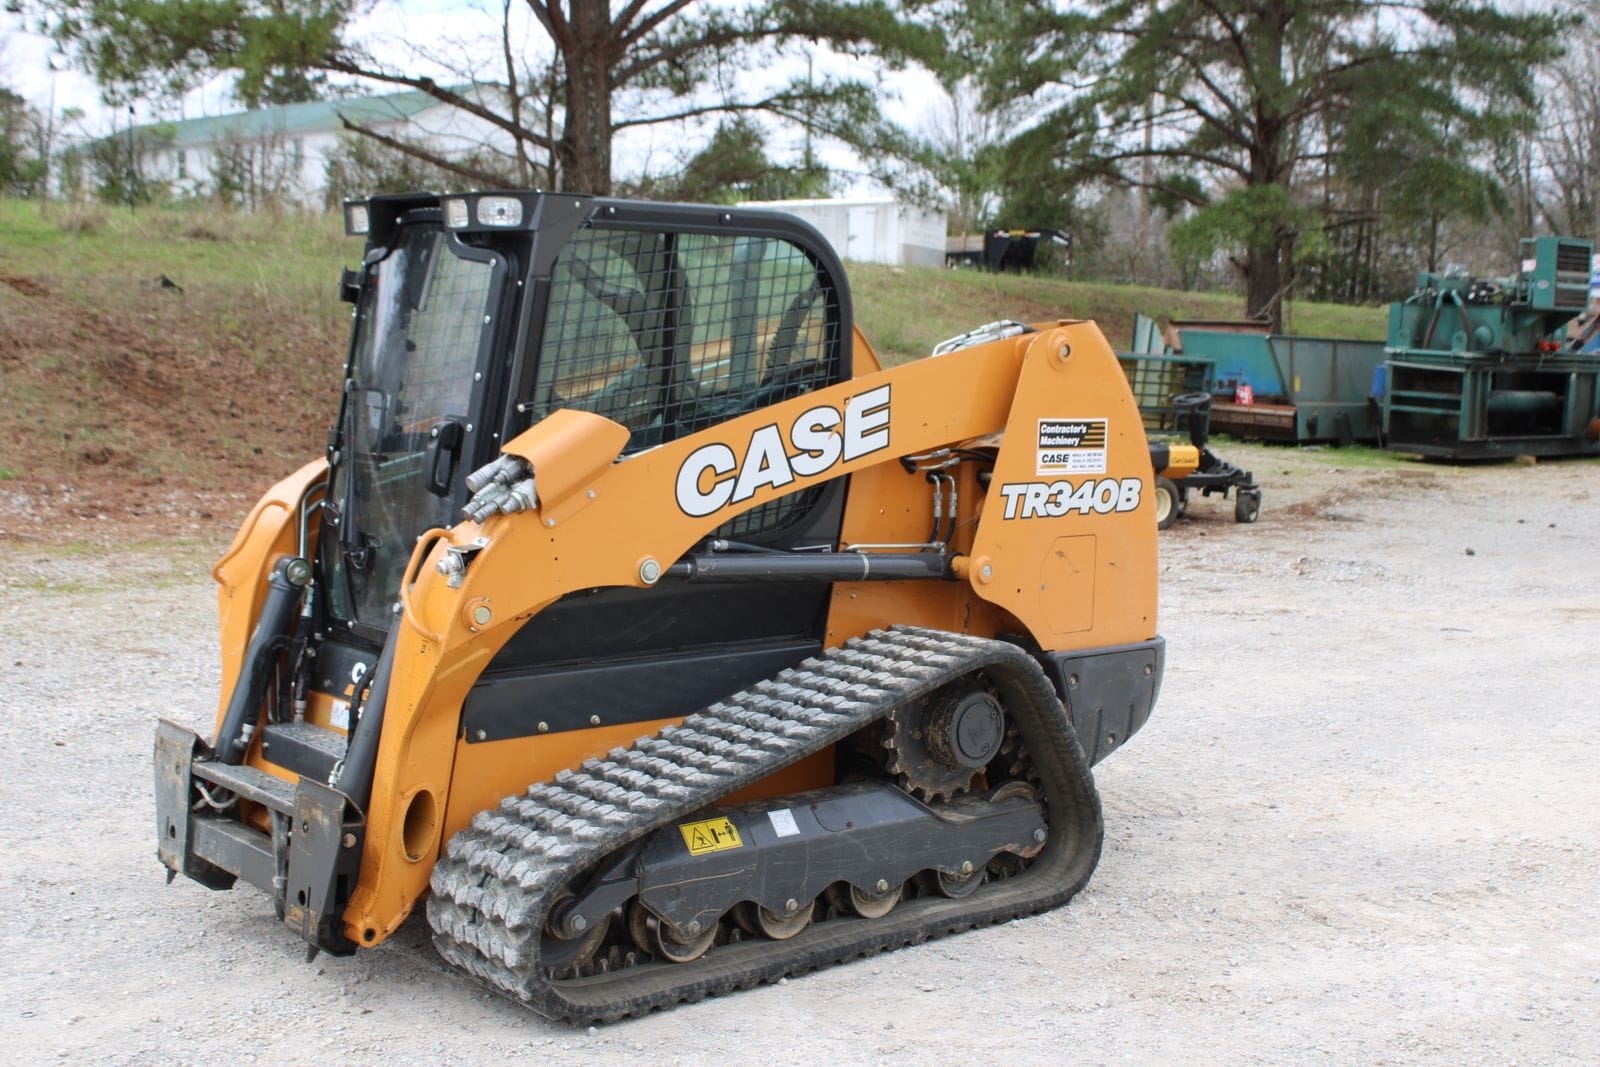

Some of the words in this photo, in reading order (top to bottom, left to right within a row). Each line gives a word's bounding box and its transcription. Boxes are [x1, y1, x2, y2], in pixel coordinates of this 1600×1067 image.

[675, 383, 891, 518] CASE
[1040, 435, 1080, 446] Machinery
[1041, 454, 1070, 463] CASE
[1000, 478, 1143, 520] TR340B
